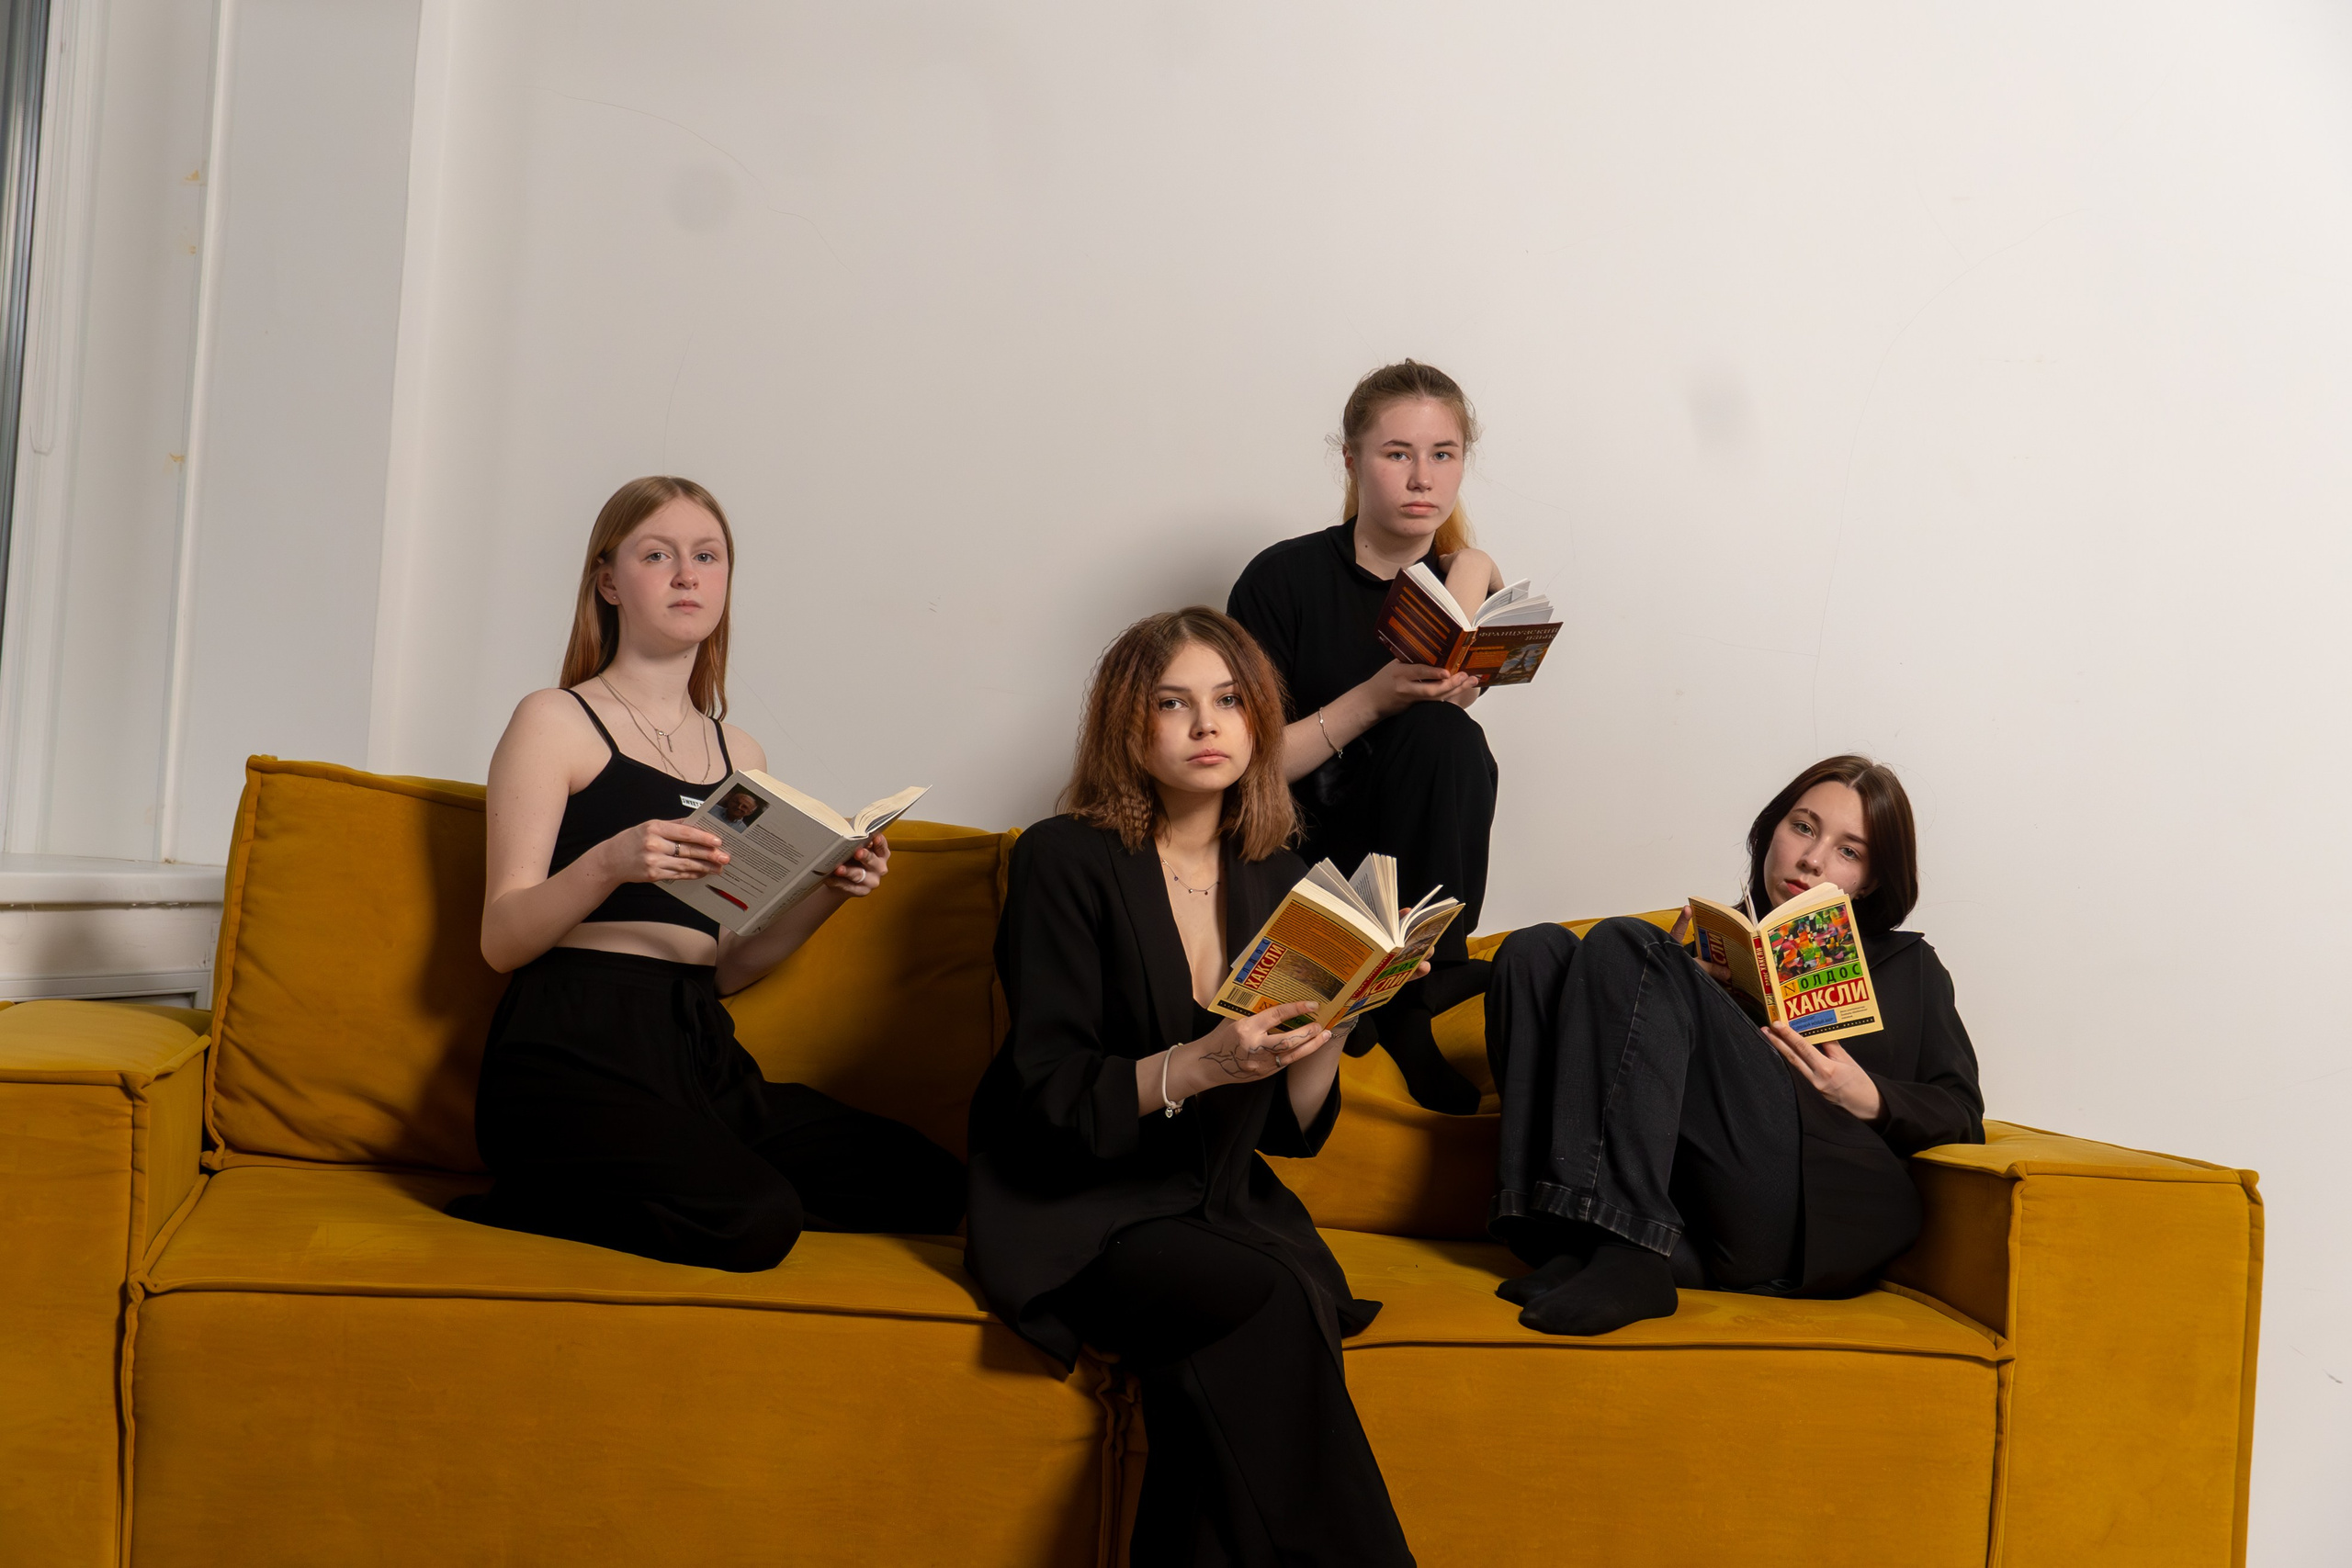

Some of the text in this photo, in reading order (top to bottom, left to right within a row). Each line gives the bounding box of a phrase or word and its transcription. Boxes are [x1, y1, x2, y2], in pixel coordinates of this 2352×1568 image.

[1479, 627, 1558, 637] ФРАНЦУЗСКИЙ
[1236, 940, 1271, 983] ОЛДОС
[1245, 943, 1285, 989] ХАКСЛИ
[1755, 947, 1768, 971] ХАКСЛИ
[1801, 964, 1861, 989] ОЛДОС
[1786, 980, 1868, 1019] ХАКСЛИ
